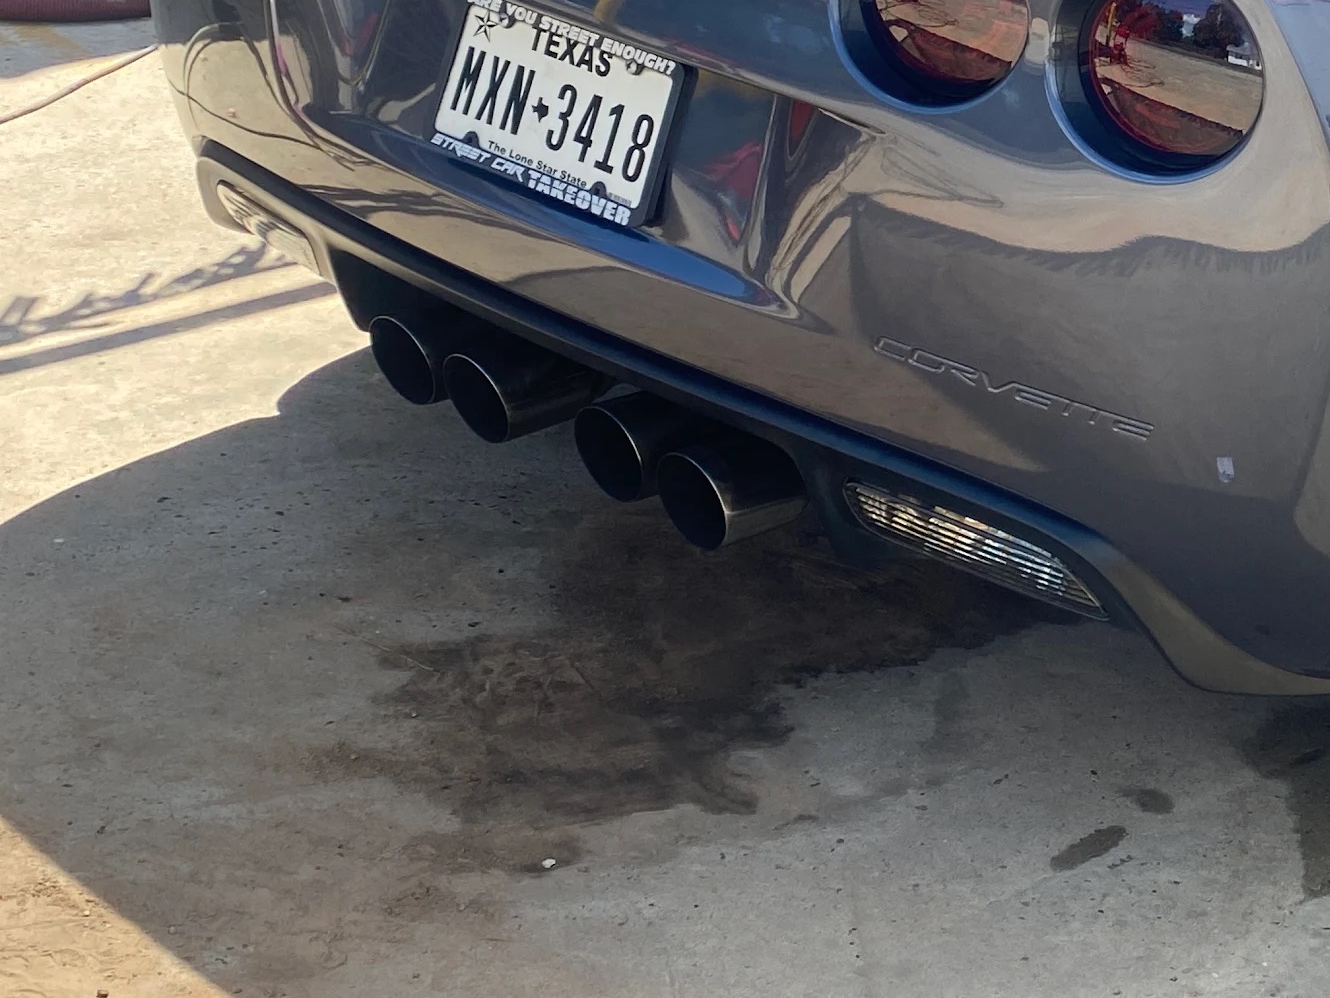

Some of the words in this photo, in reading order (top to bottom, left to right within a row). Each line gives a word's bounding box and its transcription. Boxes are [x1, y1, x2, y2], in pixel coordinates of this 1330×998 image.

[506, 3, 538, 25] YOU
[539, 15, 599, 47] STREET
[600, 37, 676, 75] ENOUGH?
[531, 27, 613, 77] TEXAS
[450, 46, 536, 135] MXN
[545, 84, 654, 183] 3418
[430, 133, 491, 163] STREET
[491, 158, 525, 183] CAR
[527, 170, 631, 226] TAKEOVER
[488, 140, 506, 155] The
[509, 150, 533, 167] Lone
[536, 161, 557, 176] Star
[559, 170, 587, 188] State
[874, 335, 1154, 441] CORVETTE
